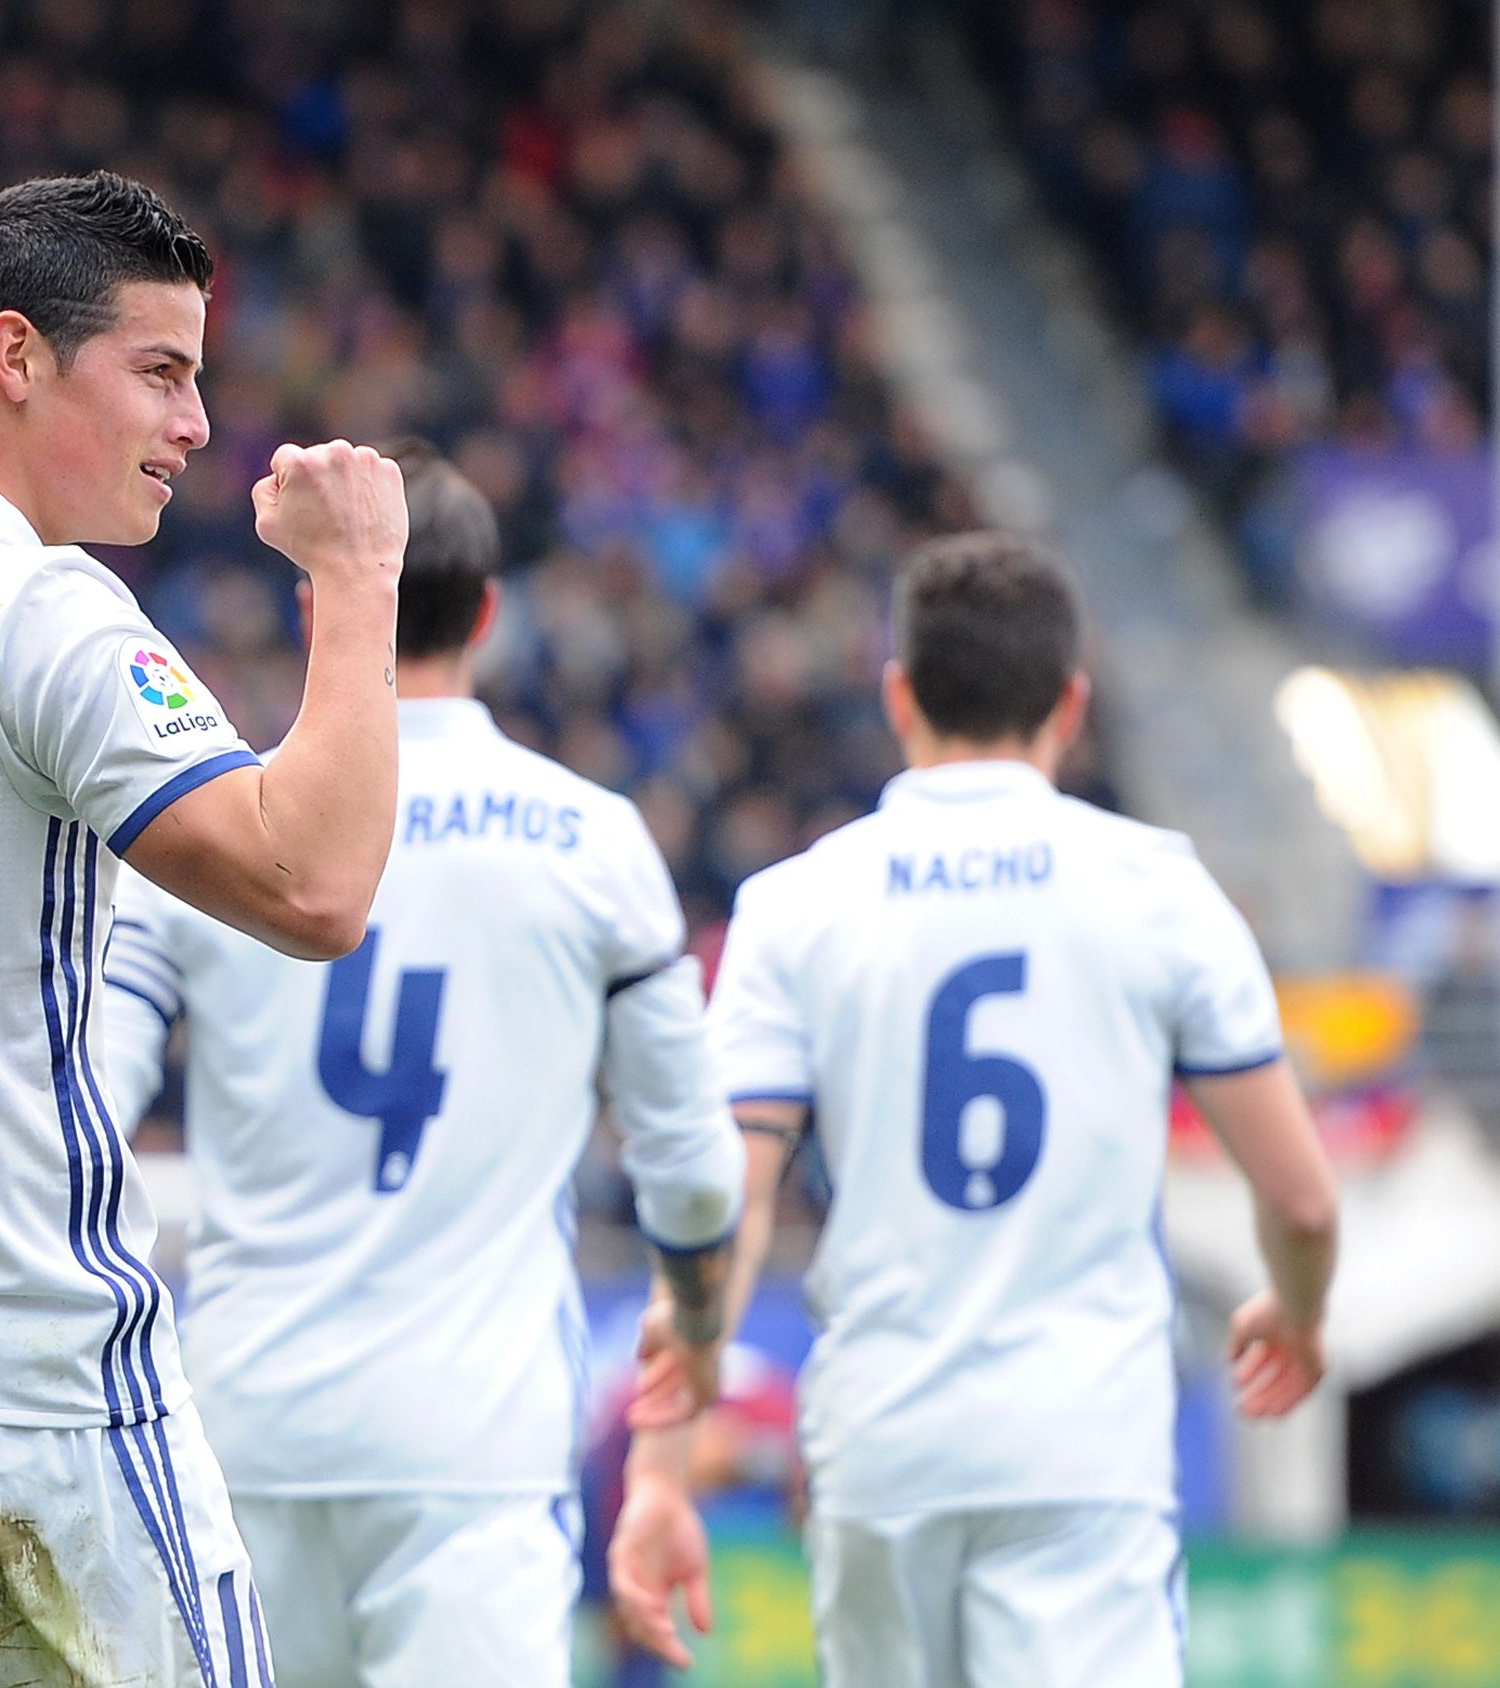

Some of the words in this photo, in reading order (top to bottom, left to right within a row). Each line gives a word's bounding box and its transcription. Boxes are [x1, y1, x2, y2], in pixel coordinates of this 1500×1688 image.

[153, 713, 218, 738] LaLiga
[403, 788, 585, 851] RAMOS
[886, 842, 1054, 896] NACHO
[314, 923, 449, 1197] 4
[918, 949, 1050, 1216] 6
